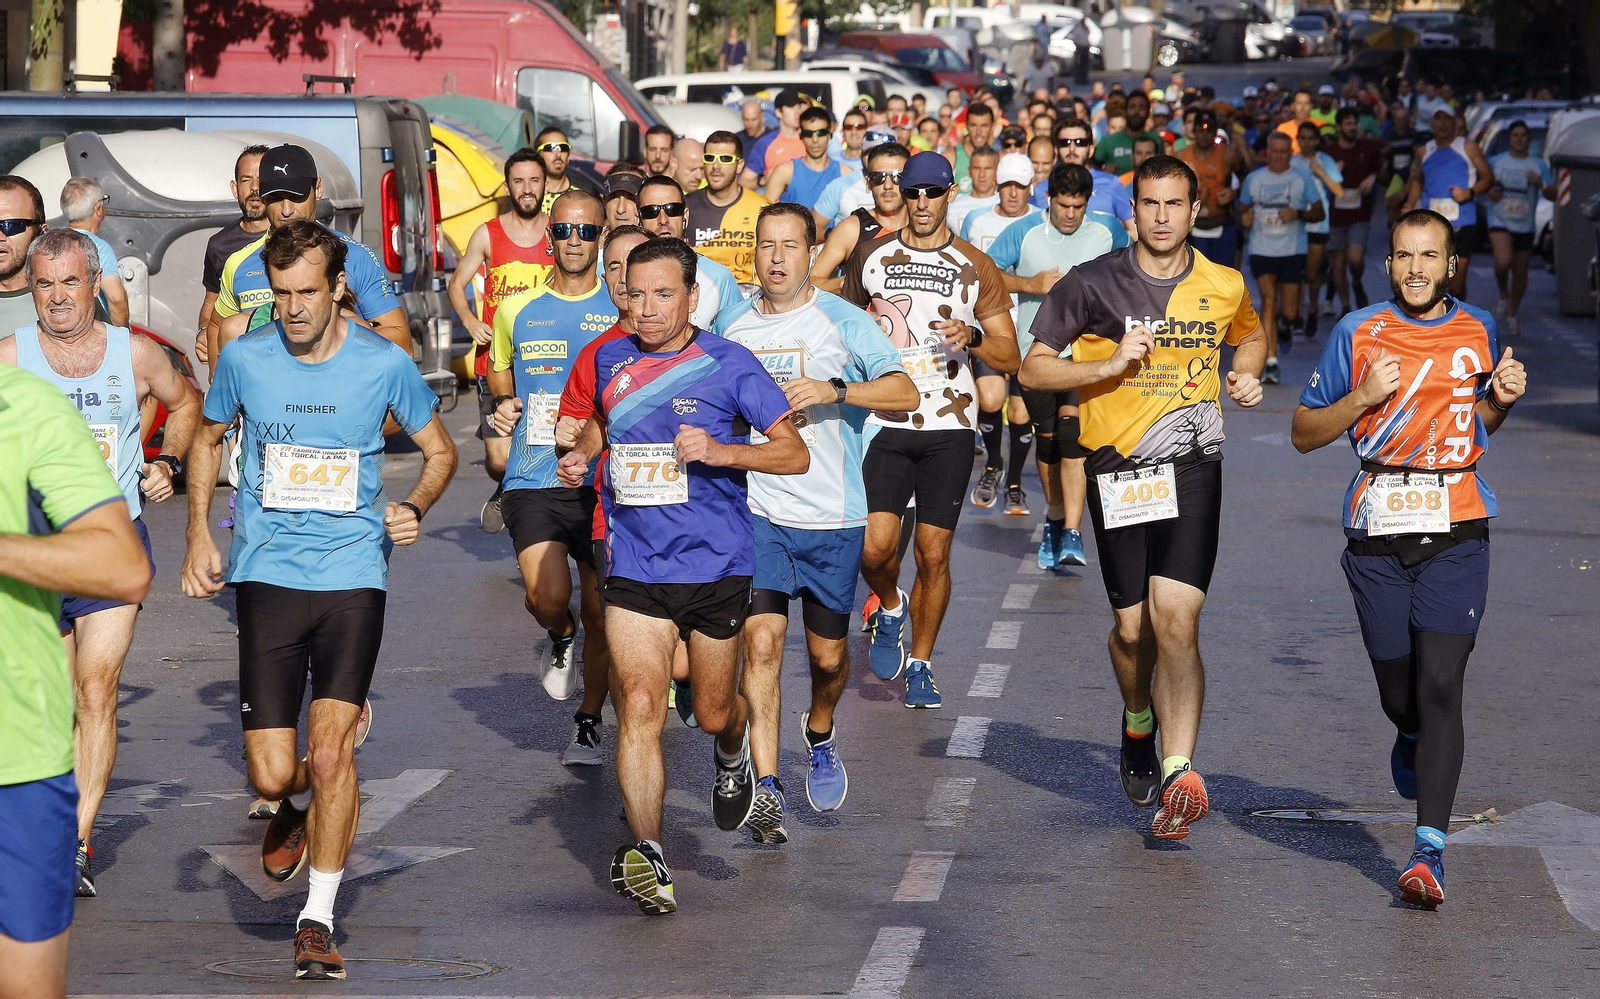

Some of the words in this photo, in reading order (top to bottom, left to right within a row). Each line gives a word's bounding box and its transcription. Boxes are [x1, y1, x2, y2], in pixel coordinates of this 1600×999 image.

[695, 227, 755, 240] bichos
[695, 240, 753, 248] runners
[886, 264, 954, 280] COCHINOS
[886, 278, 951, 294] RUNNERS
[1124, 315, 1217, 335] bichos
[1369, 319, 1387, 338] vive
[521, 343, 566, 355] naocon
[1153, 337, 1217, 348] nners
[902, 356, 940, 376] 611
[1127, 364, 1154, 372] Colegio
[1115, 380, 1178, 388] Administrativos
[65, 387, 102, 411] rja
[1152, 389, 1177, 398] Málaga
[285, 404, 336, 414] FINISHER
[545, 408, 558, 426] 3
[252, 421, 296, 442] XXIX
[1427, 418, 1438, 444] Grupo
[289, 463, 350, 487] 647
[626, 461, 679, 482] 776
[1121, 480, 1169, 504] 406
[1387, 490, 1441, 511] 698
[1382, 520, 1416, 528] DISMOAUTO
